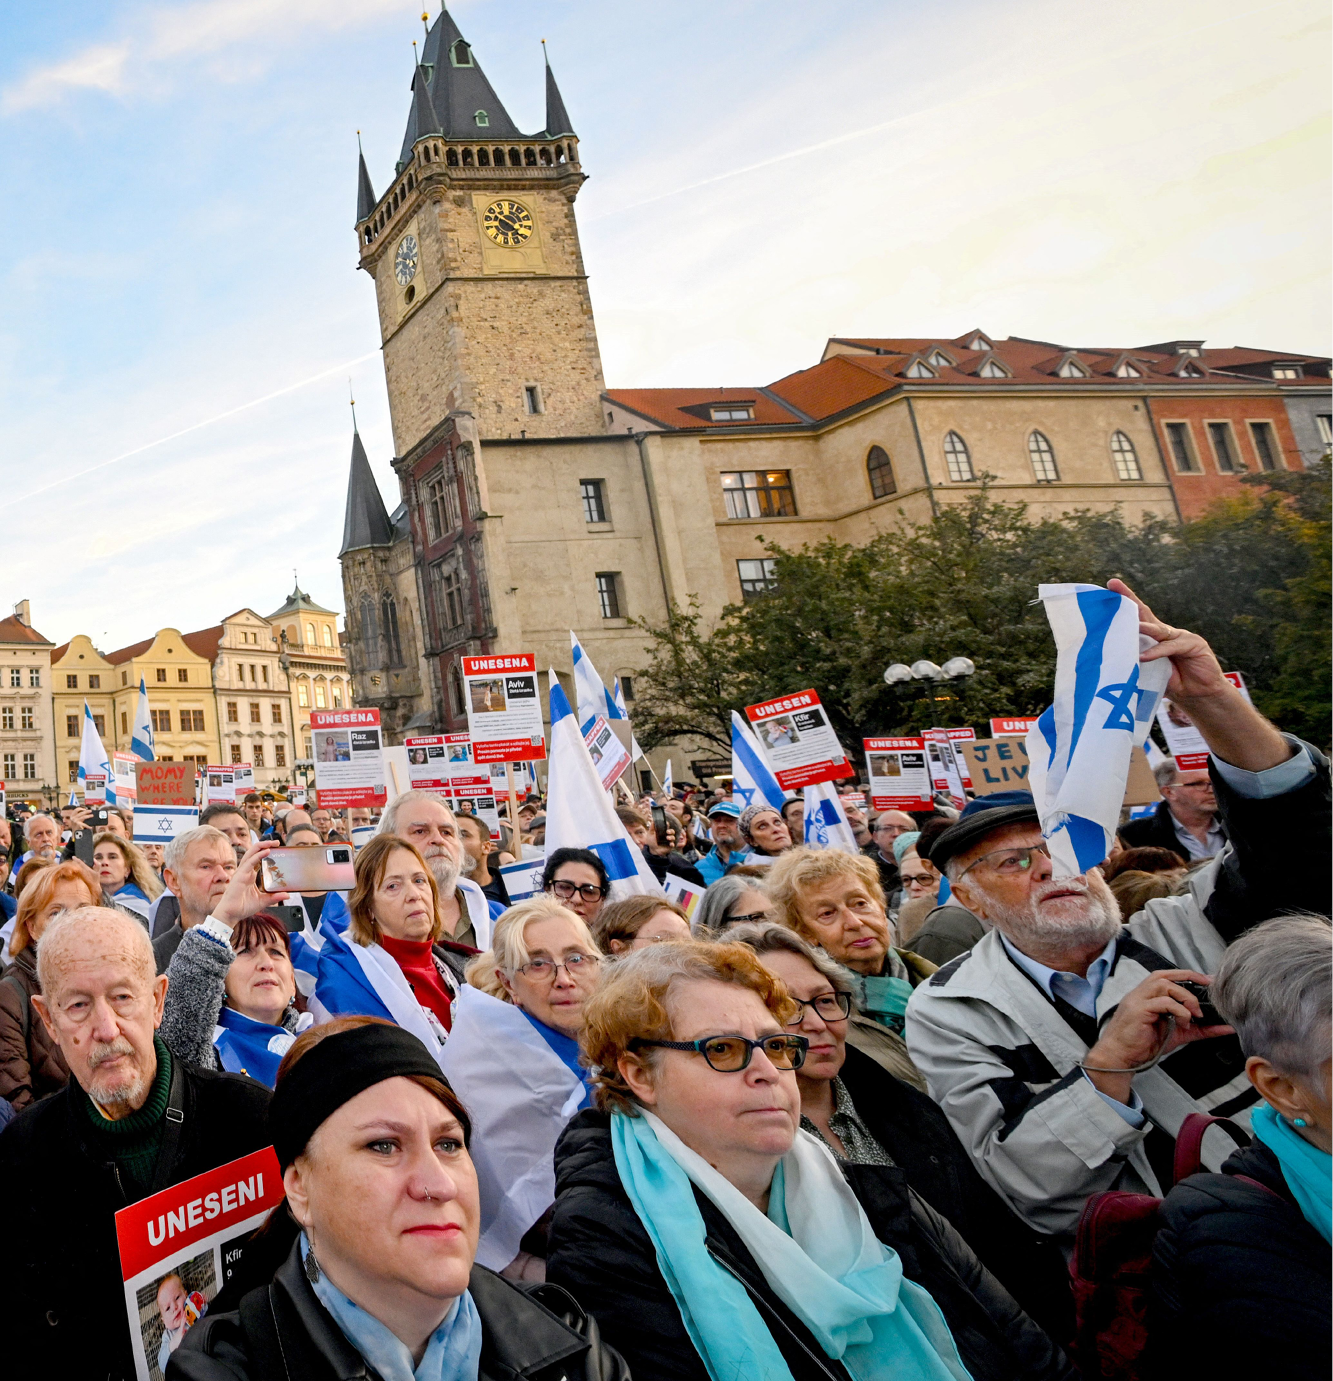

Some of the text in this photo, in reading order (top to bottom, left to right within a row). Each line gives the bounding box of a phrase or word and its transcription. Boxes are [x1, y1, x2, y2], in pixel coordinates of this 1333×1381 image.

[470, 657, 529, 670] UNESENA
[508, 680, 525, 688] Aviv
[755, 694, 812, 717] UNESEN
[317, 713, 375, 724] UNESENA
[794, 713, 810, 723] Kfir
[869, 740, 920, 748] UNESENA
[139, 766, 186, 781] MOMY
[139, 781, 183, 794] WHERE
[146, 1172, 265, 1247] UNESENI
[225, 1247, 243, 1265] Kfir
